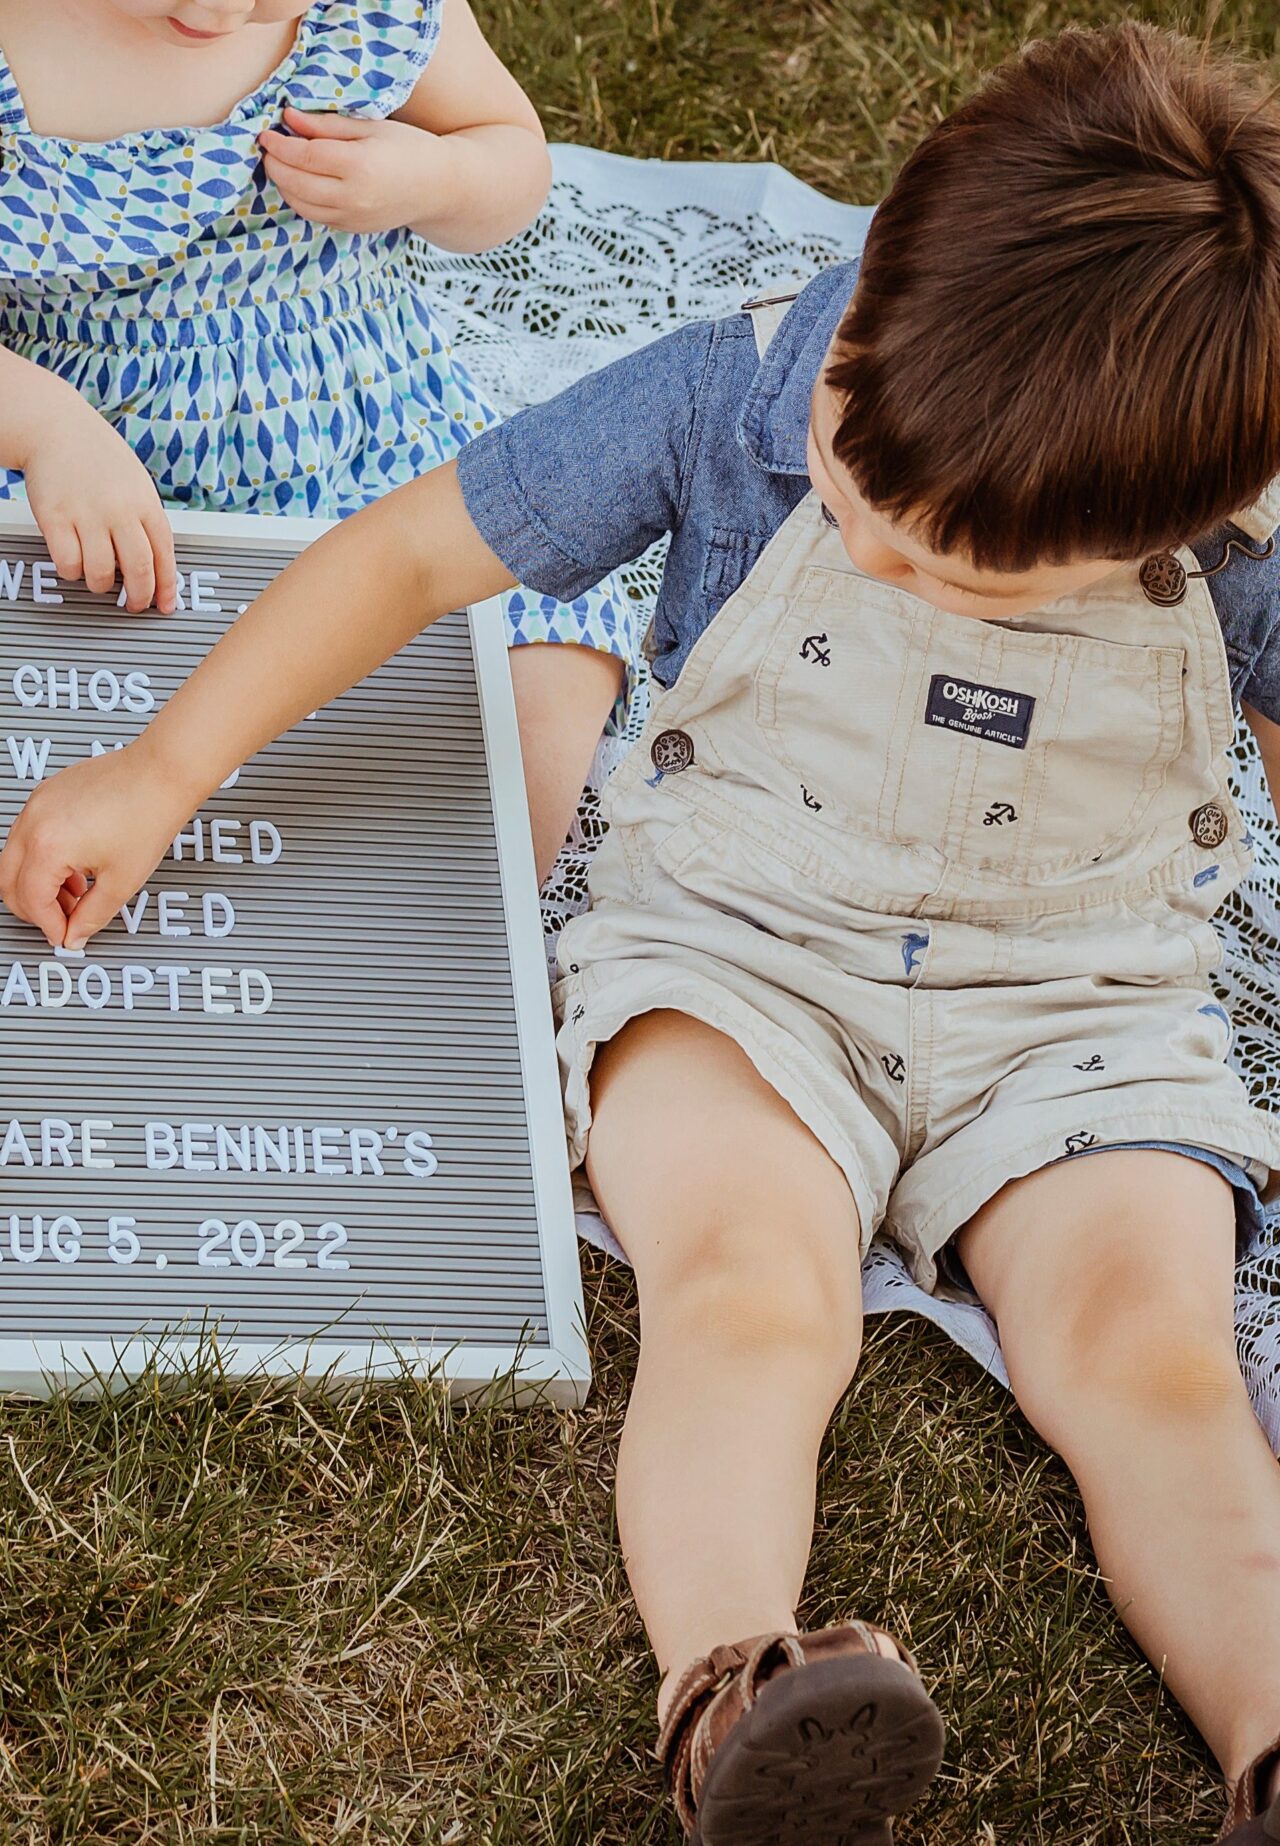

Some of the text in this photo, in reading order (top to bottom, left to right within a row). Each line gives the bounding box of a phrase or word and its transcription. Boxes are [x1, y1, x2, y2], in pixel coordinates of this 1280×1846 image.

[12, 664, 155, 714] CHOS
[932, 714, 946, 724] THE
[948, 718, 983, 735] GENUINE
[0, 960, 274, 1015] ADOPTED
[145, 1121, 438, 1178] BENNIER'S
[197, 1218, 351, 1270] 2022
